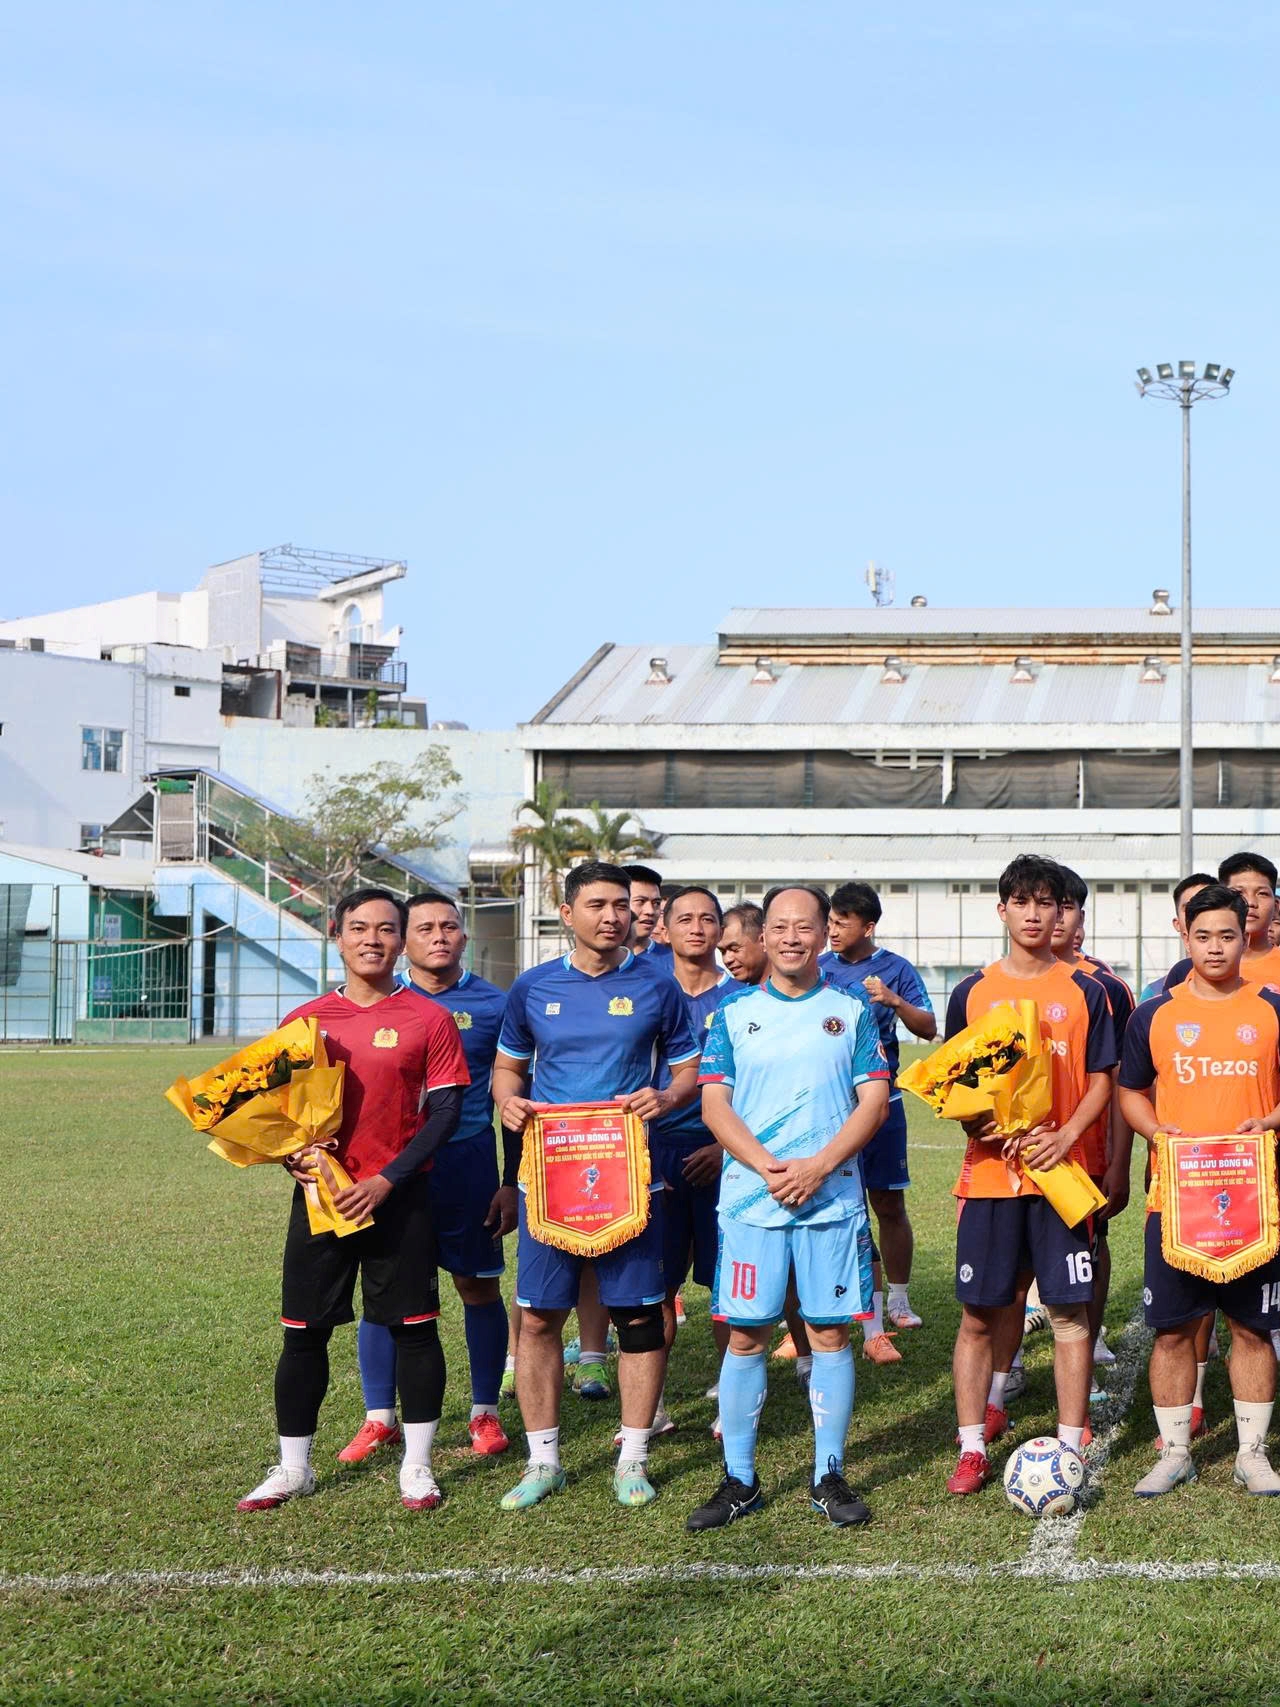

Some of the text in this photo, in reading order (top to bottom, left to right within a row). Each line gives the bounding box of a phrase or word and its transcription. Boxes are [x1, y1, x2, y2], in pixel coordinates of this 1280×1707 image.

[1197, 1056, 1258, 1077] Tezos
[546, 1135, 567, 1146] GIAO
[1180, 1160, 1199, 1170] GIAO
[1065, 1250, 1093, 1285] 16
[731, 1260, 757, 1301] 10
